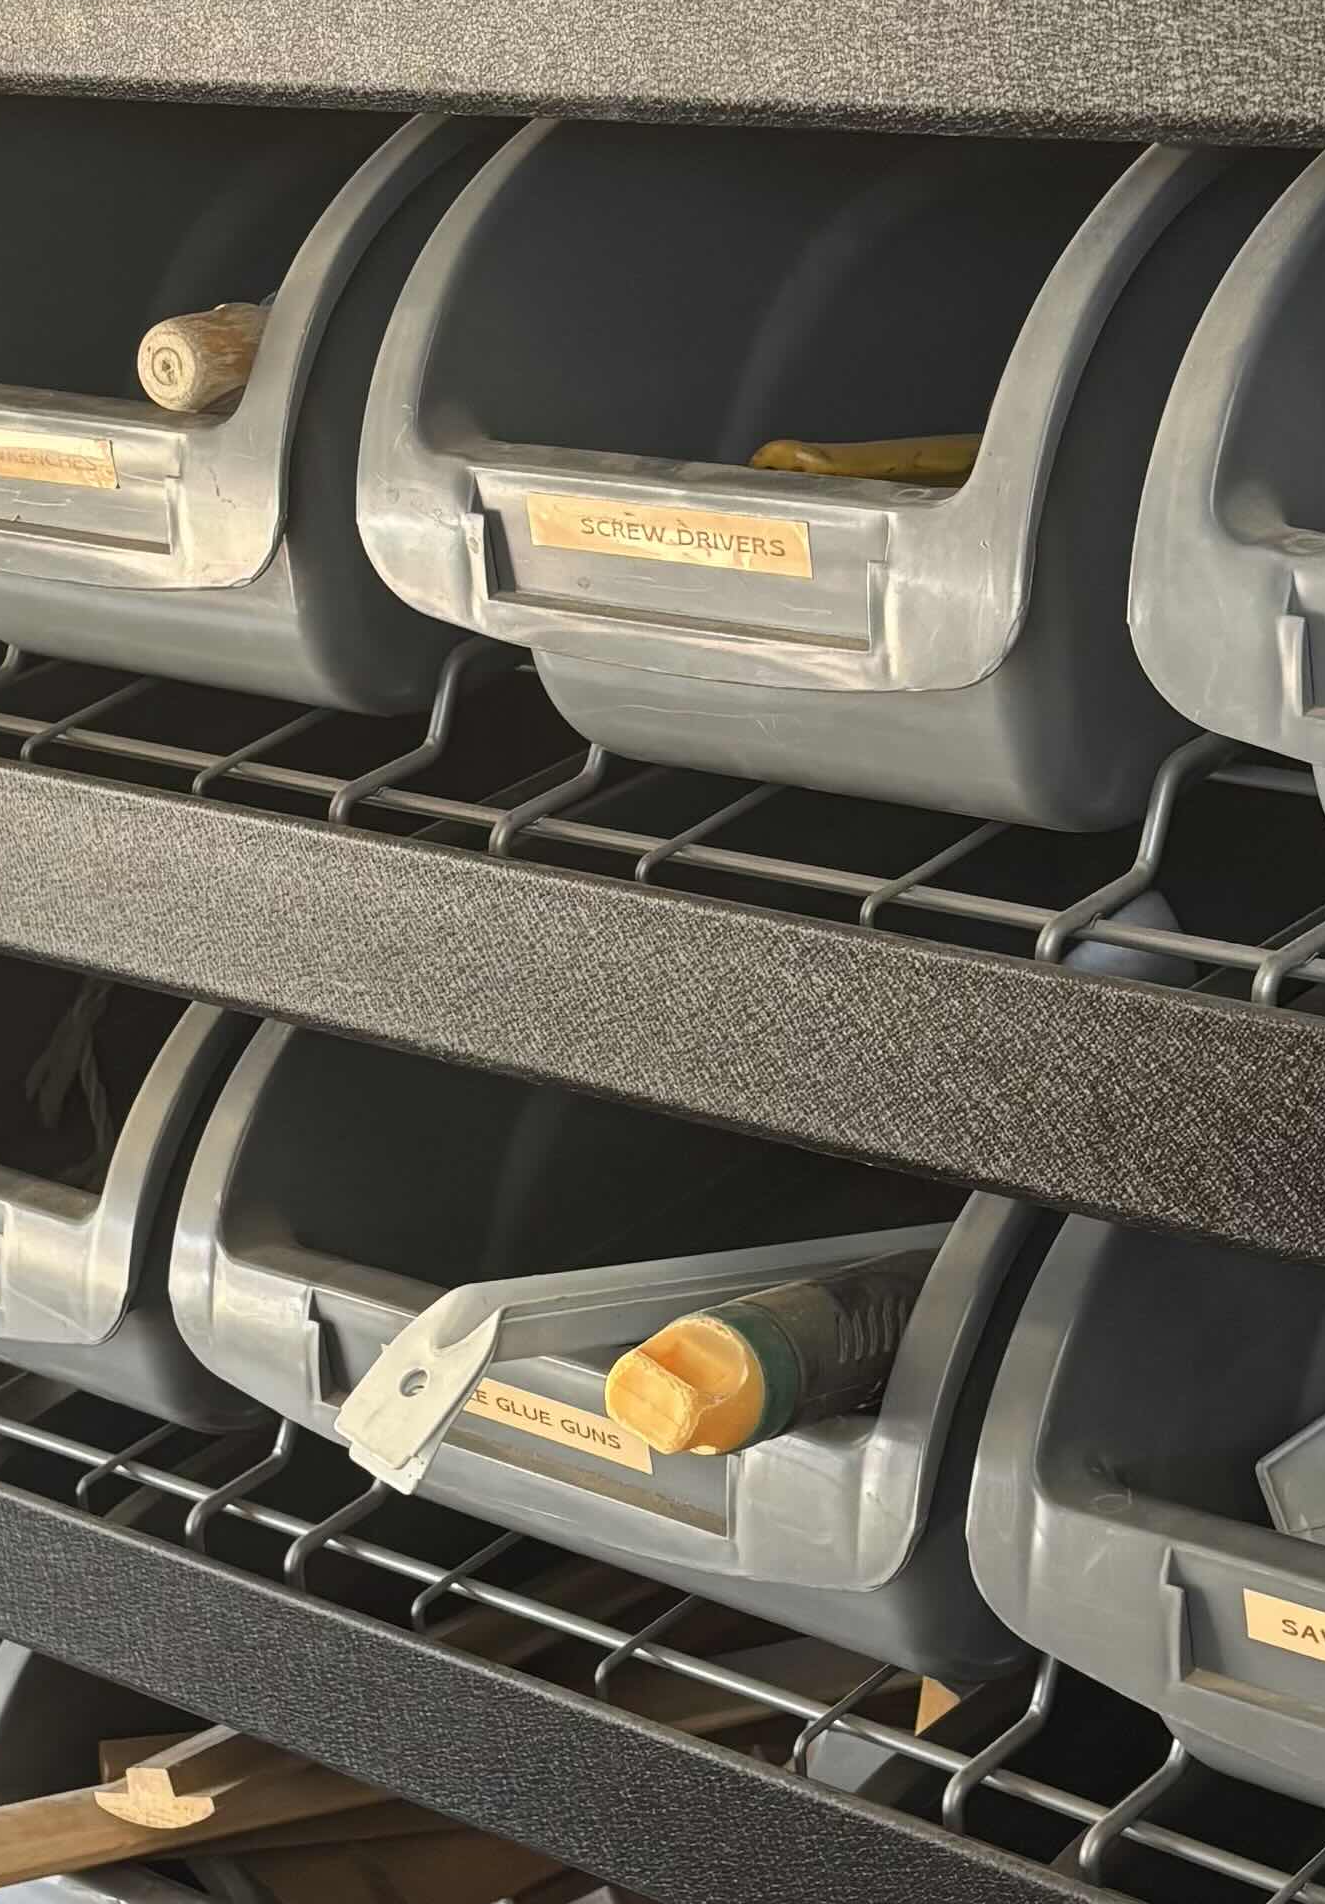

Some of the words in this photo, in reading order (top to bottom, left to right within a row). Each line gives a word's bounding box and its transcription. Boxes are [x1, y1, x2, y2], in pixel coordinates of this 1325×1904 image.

[580, 516, 666, 544] SCREW
[677, 527, 786, 558] DRIVERS
[496, 1396, 554, 1426] GLUE
[560, 1418, 621, 1450] GUNS
